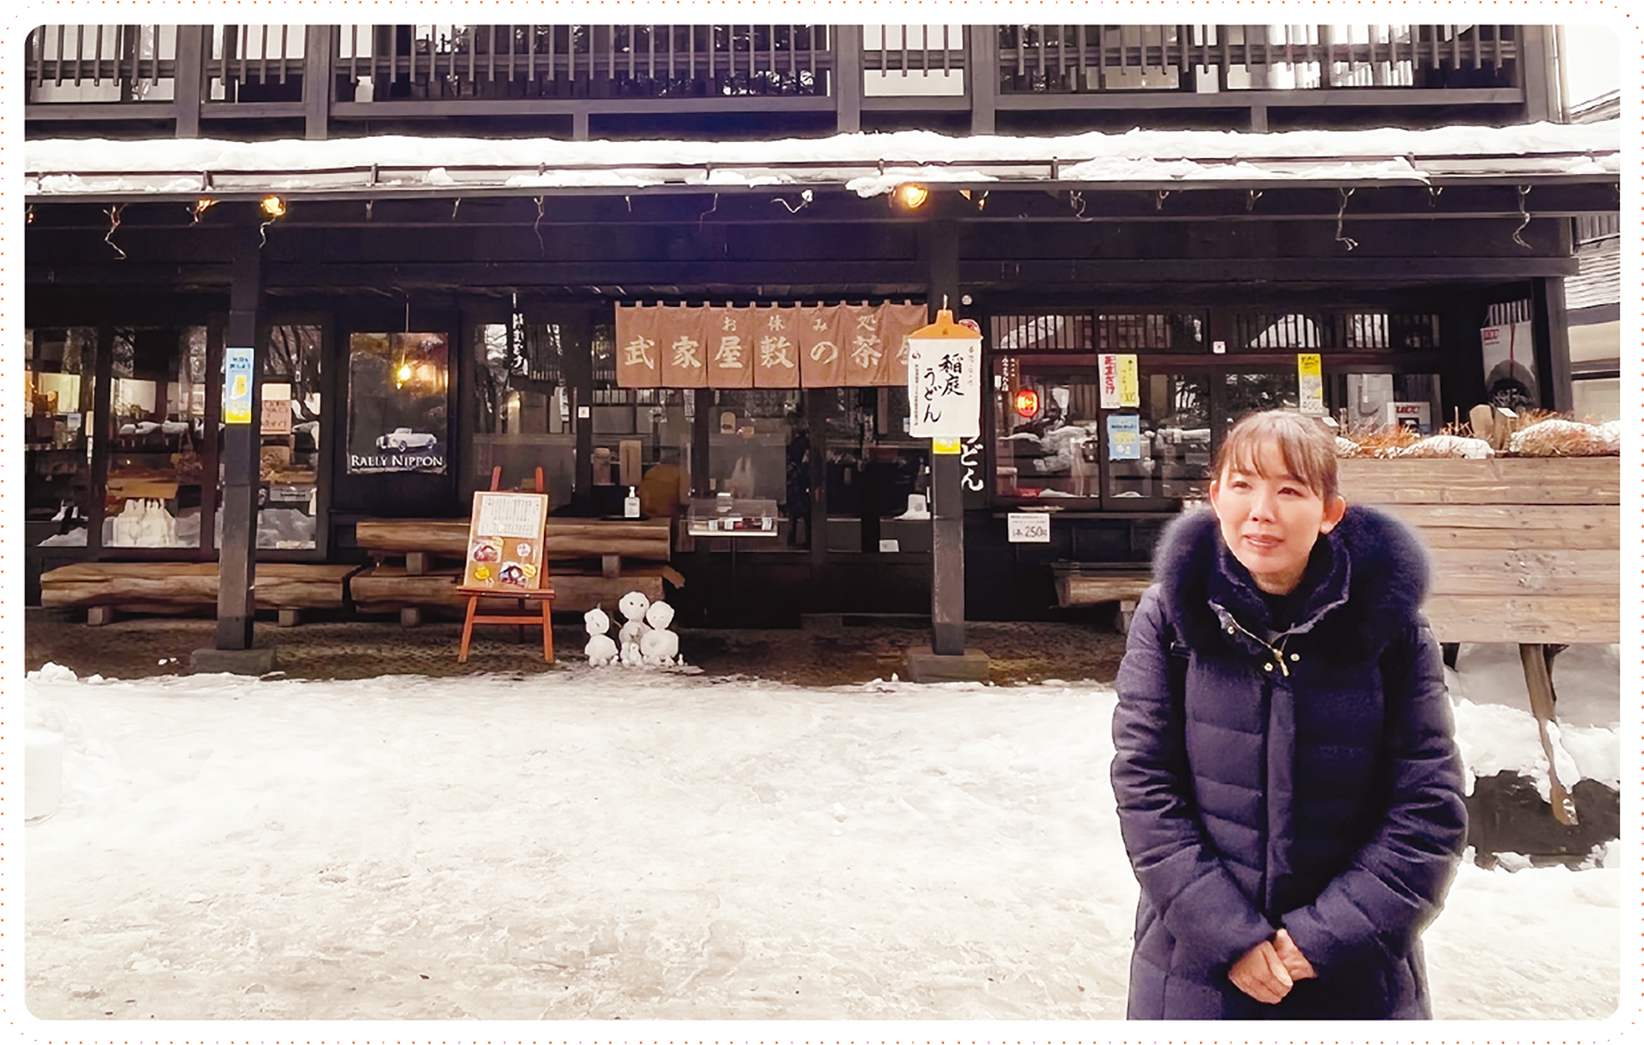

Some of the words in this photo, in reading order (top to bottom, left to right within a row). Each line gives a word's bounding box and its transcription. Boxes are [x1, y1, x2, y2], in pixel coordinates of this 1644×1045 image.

[722, 314, 878, 333] お休み処
[938, 353, 965, 397] 稲庭
[923, 367, 943, 423] うどん
[1396, 405, 1421, 414] UCC
[351, 454, 388, 467] RALLY
[392, 454, 443, 467] NIPPON
[960, 437, 985, 492] どん
